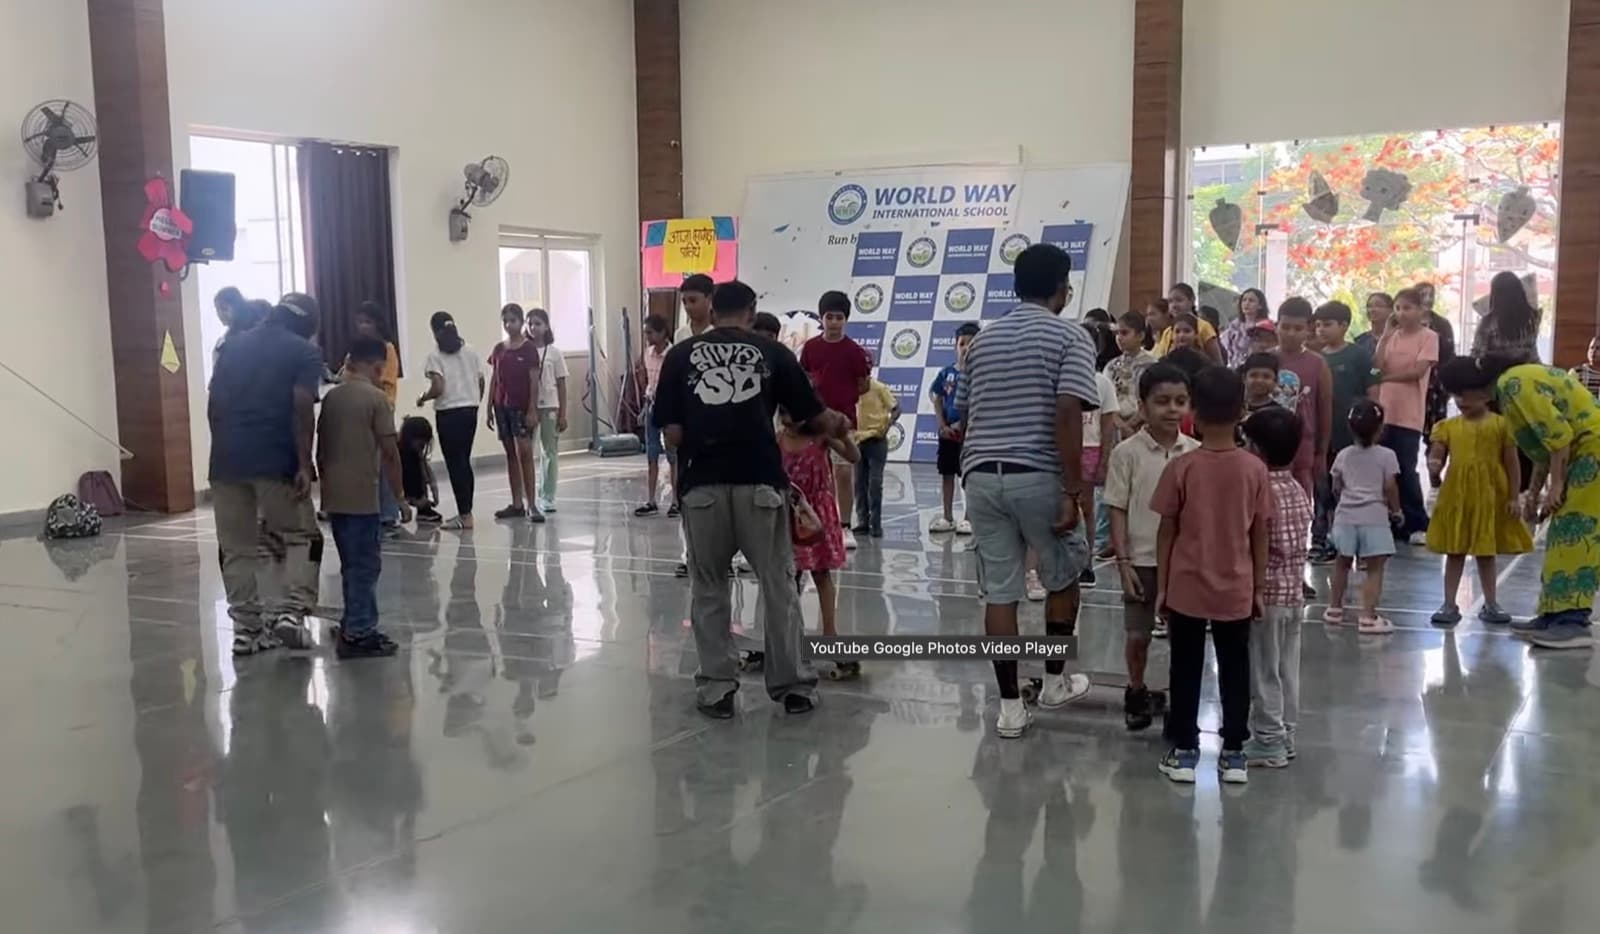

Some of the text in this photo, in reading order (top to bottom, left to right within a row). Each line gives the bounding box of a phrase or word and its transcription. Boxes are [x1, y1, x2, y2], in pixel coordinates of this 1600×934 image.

[874, 186, 956, 206] WORLD
[962, 184, 1016, 203] WAY
[872, 206, 1009, 220] INTERNATIONAL SCHOOL
[828, 235, 848, 246] Run
[1070, 240, 1087, 248] WAY
[882, 247, 896, 255] WAY
[948, 244, 989, 253] WORLD WAY
[895, 291, 934, 300] WORLD WAY
